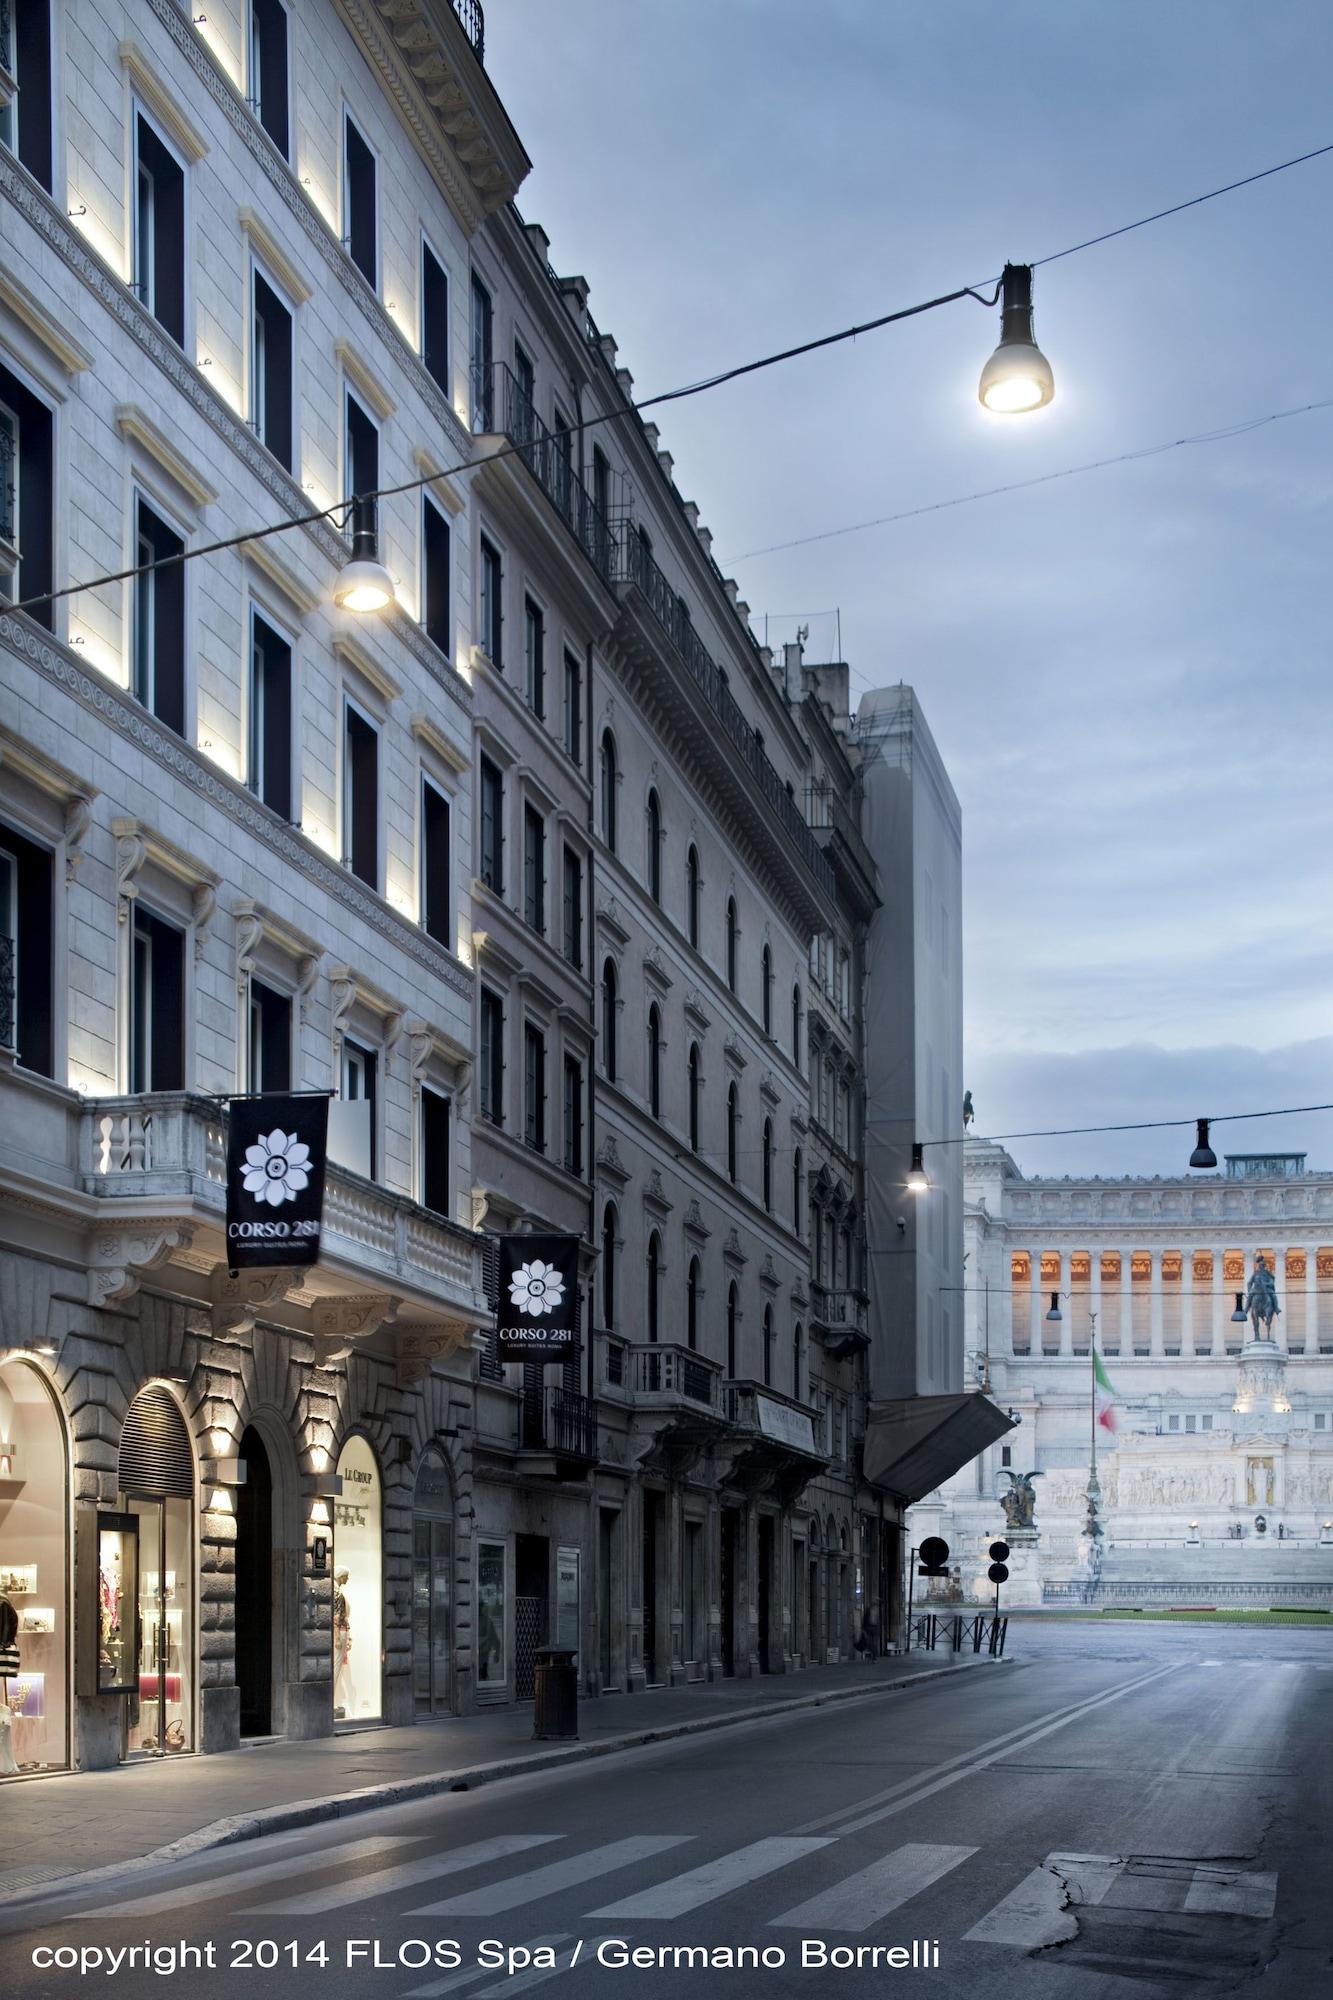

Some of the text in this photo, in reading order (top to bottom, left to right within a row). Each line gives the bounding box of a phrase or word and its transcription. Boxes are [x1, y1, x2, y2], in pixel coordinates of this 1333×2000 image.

[228, 1220, 320, 1238] CORSO 281
[499, 1328, 572, 1342] CORSO 281
